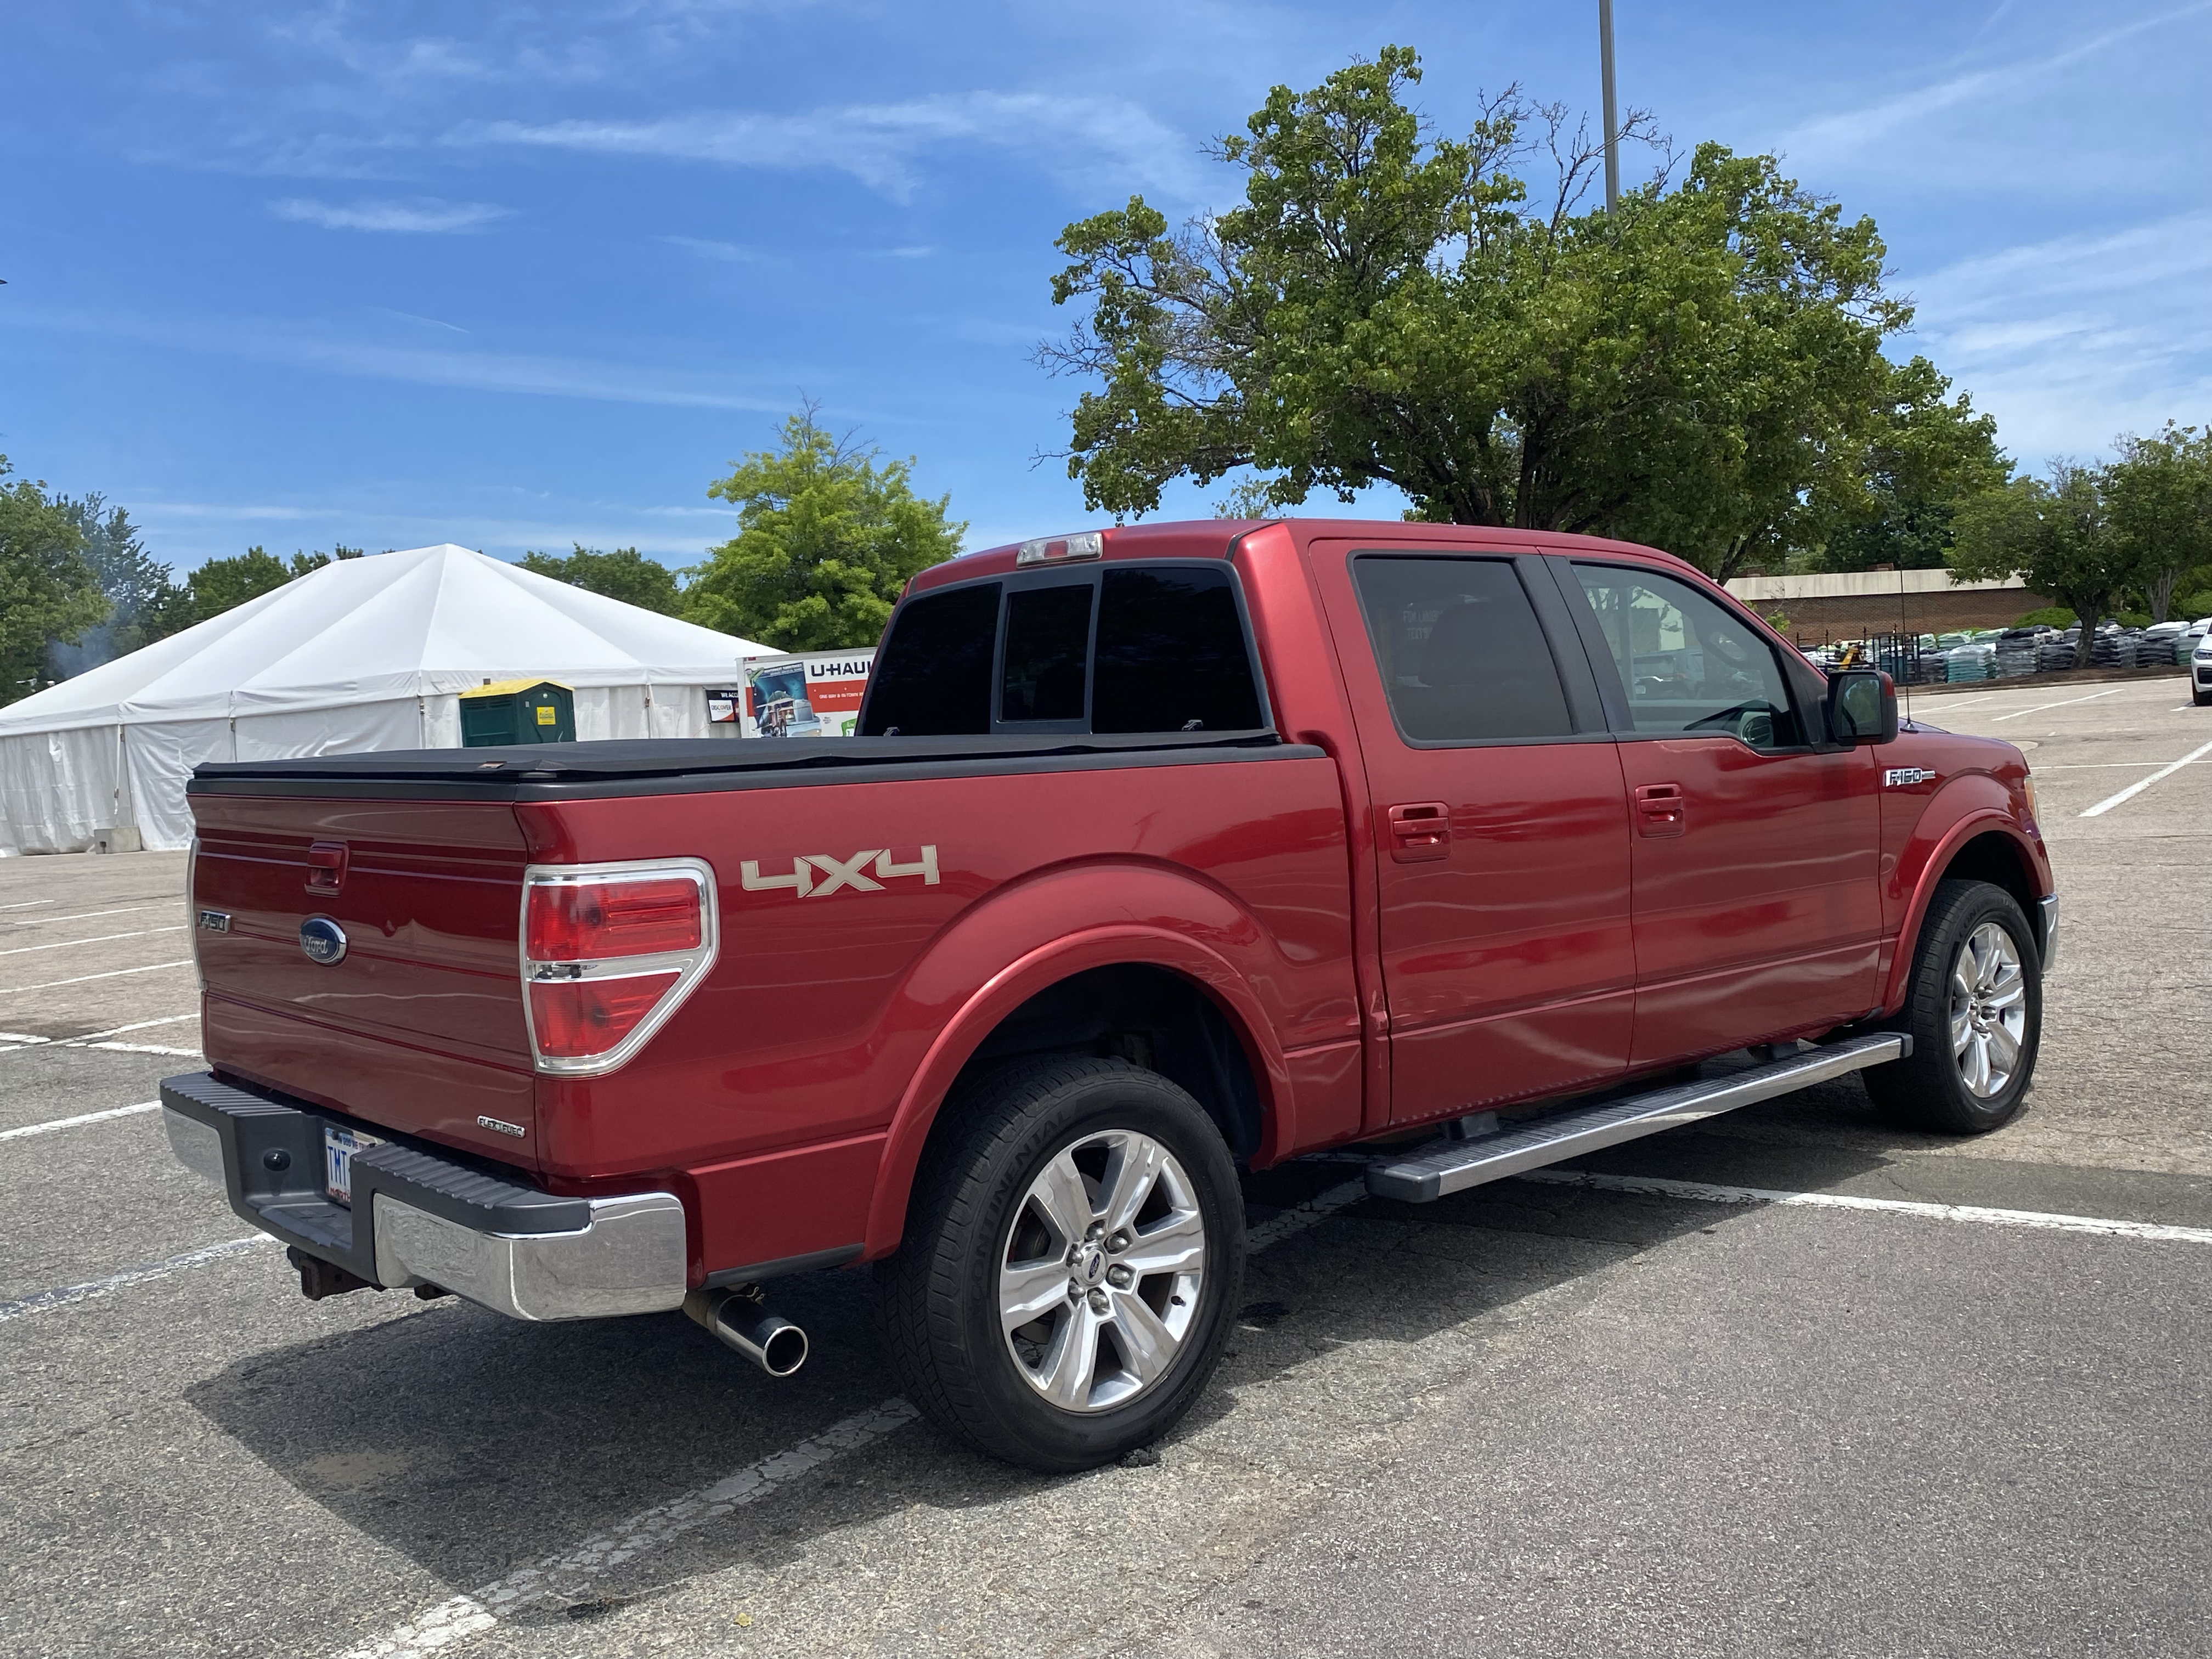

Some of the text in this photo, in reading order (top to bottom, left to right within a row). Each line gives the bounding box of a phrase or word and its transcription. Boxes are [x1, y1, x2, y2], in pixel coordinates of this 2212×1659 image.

[1889, 769, 1921, 785] F-150
[200, 912, 227, 932] F-150
[304, 934, 328, 955] Ford
[479, 1118, 522, 1137] FLEX FUEL
[971, 1110, 1071, 1305] CONTINENTAL
